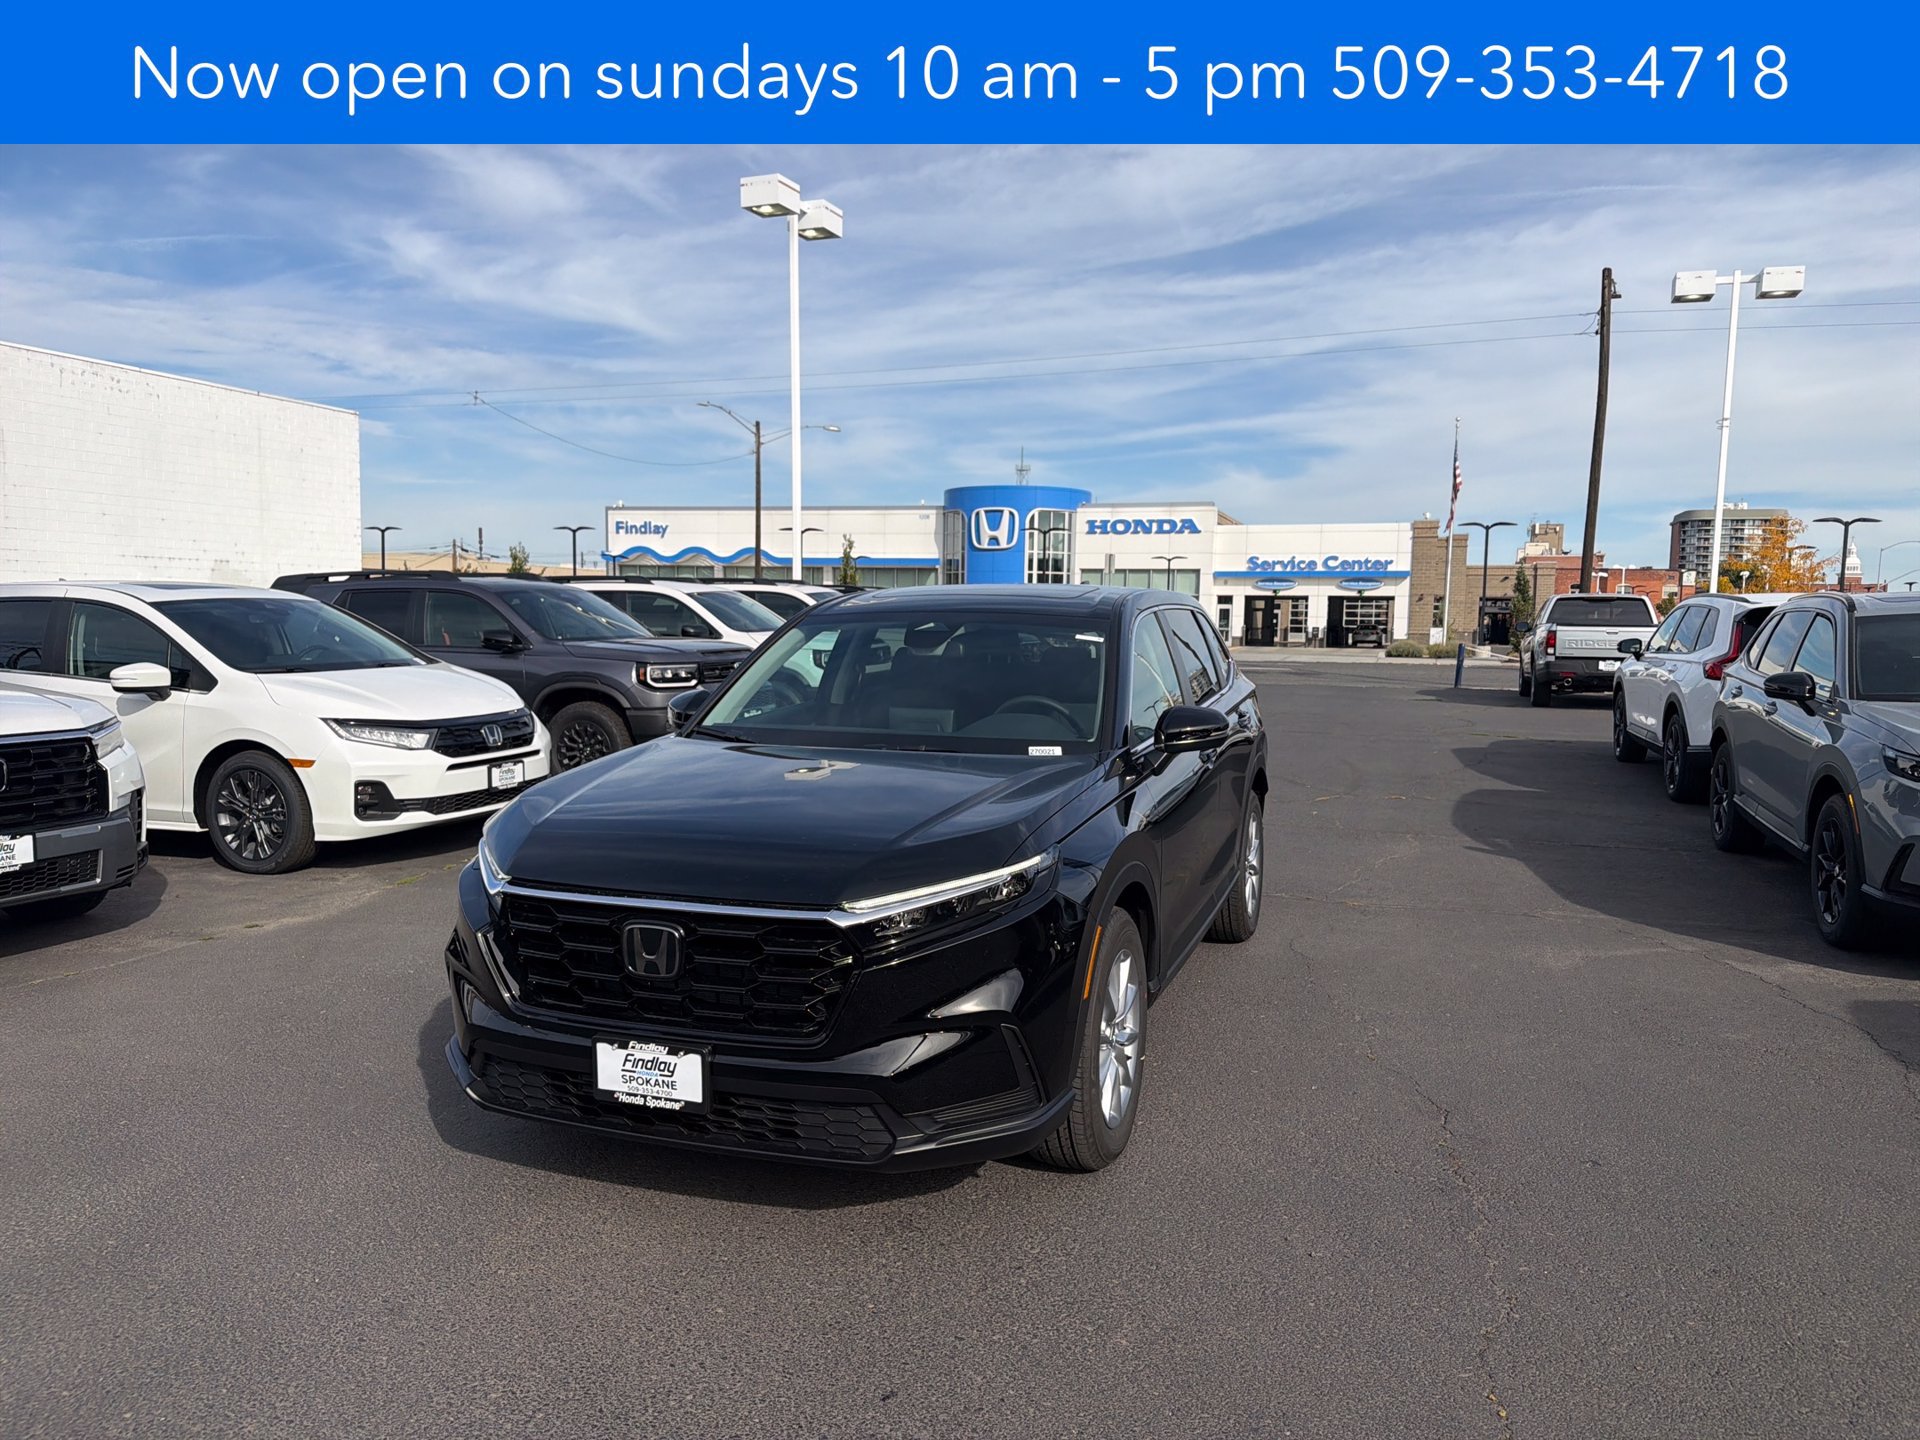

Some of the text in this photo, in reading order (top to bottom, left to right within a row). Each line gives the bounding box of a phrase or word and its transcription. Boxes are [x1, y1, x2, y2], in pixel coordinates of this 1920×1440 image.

[615, 520, 669, 539] Findlay
[1086, 518, 1201, 535] HONDA
[1247, 555, 1394, 571] Service Center
[1565, 639, 1619, 648] RIDGE
[628, 1041, 669, 1054] Findlay
[622, 1053, 677, 1077] Findlay
[621, 1074, 678, 1091] SPOKANE
[636, 1070, 659, 1078] HONDA
[618, 1092, 681, 1110] Honda Spokane
